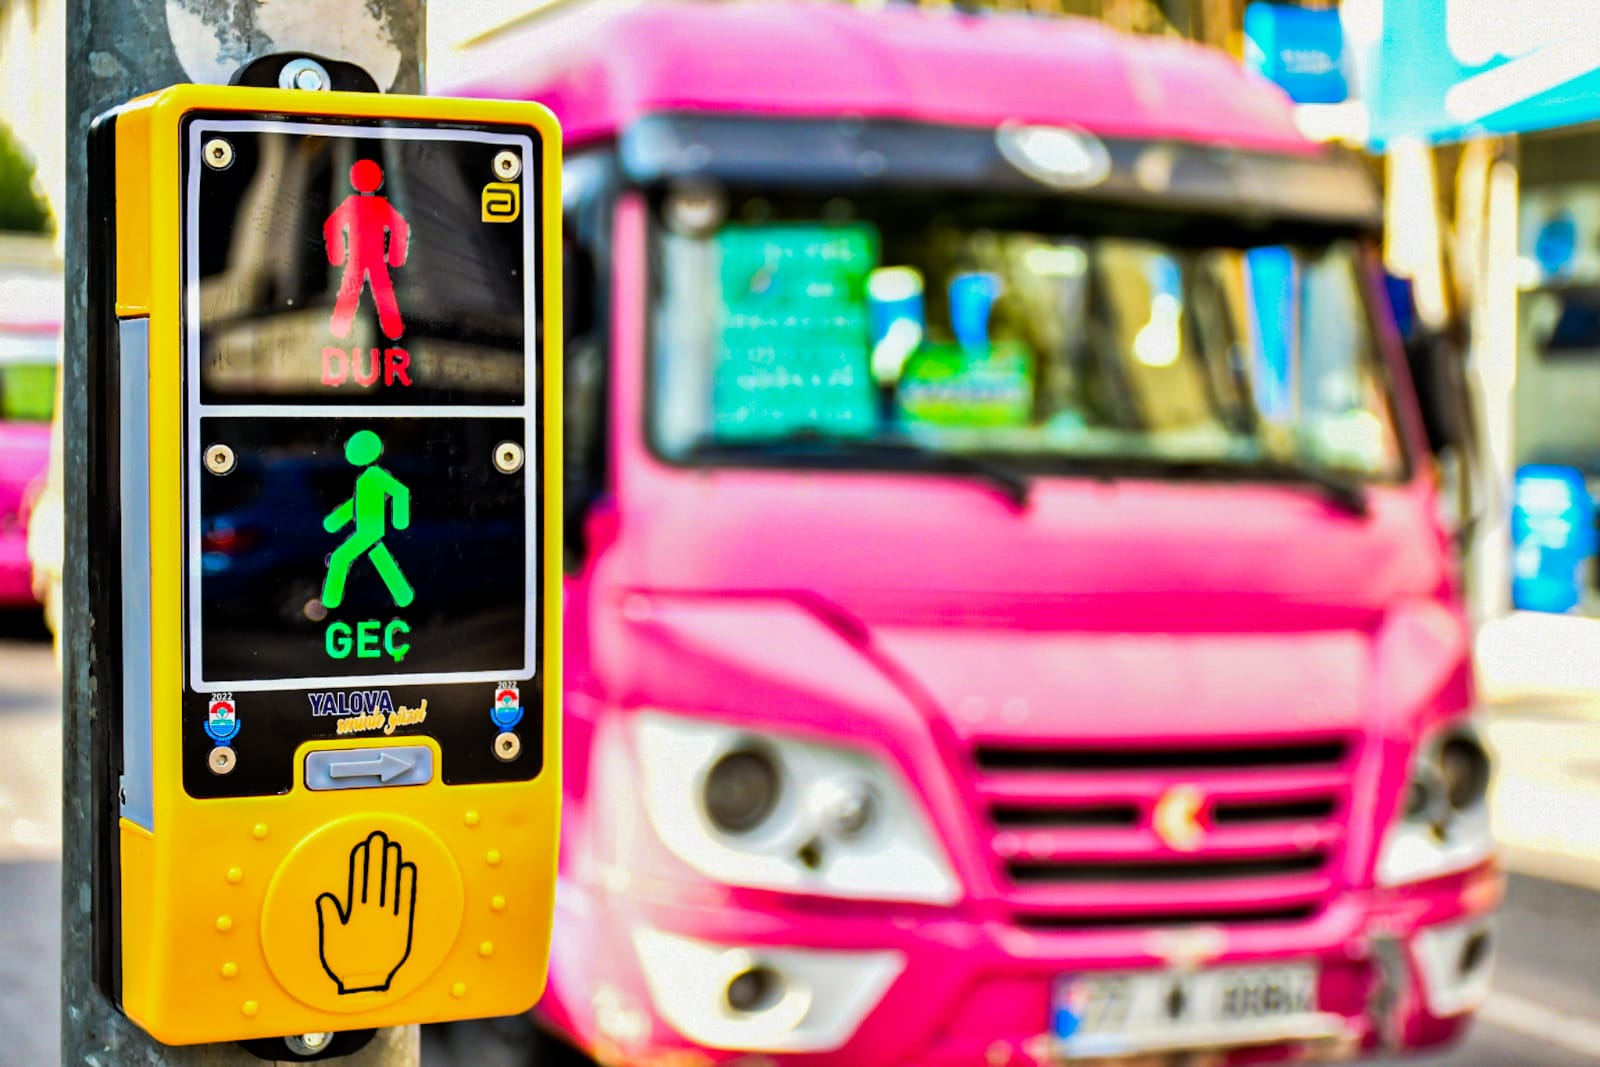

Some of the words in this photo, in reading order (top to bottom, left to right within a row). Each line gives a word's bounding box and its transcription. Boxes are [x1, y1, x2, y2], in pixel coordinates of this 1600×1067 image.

[321, 347, 413, 387] DUR
[325, 617, 411, 662] GEÇ
[211, 691, 233, 701] 2022
[497, 680, 517, 689] 2022
[308, 690, 394, 716] YALOVA
